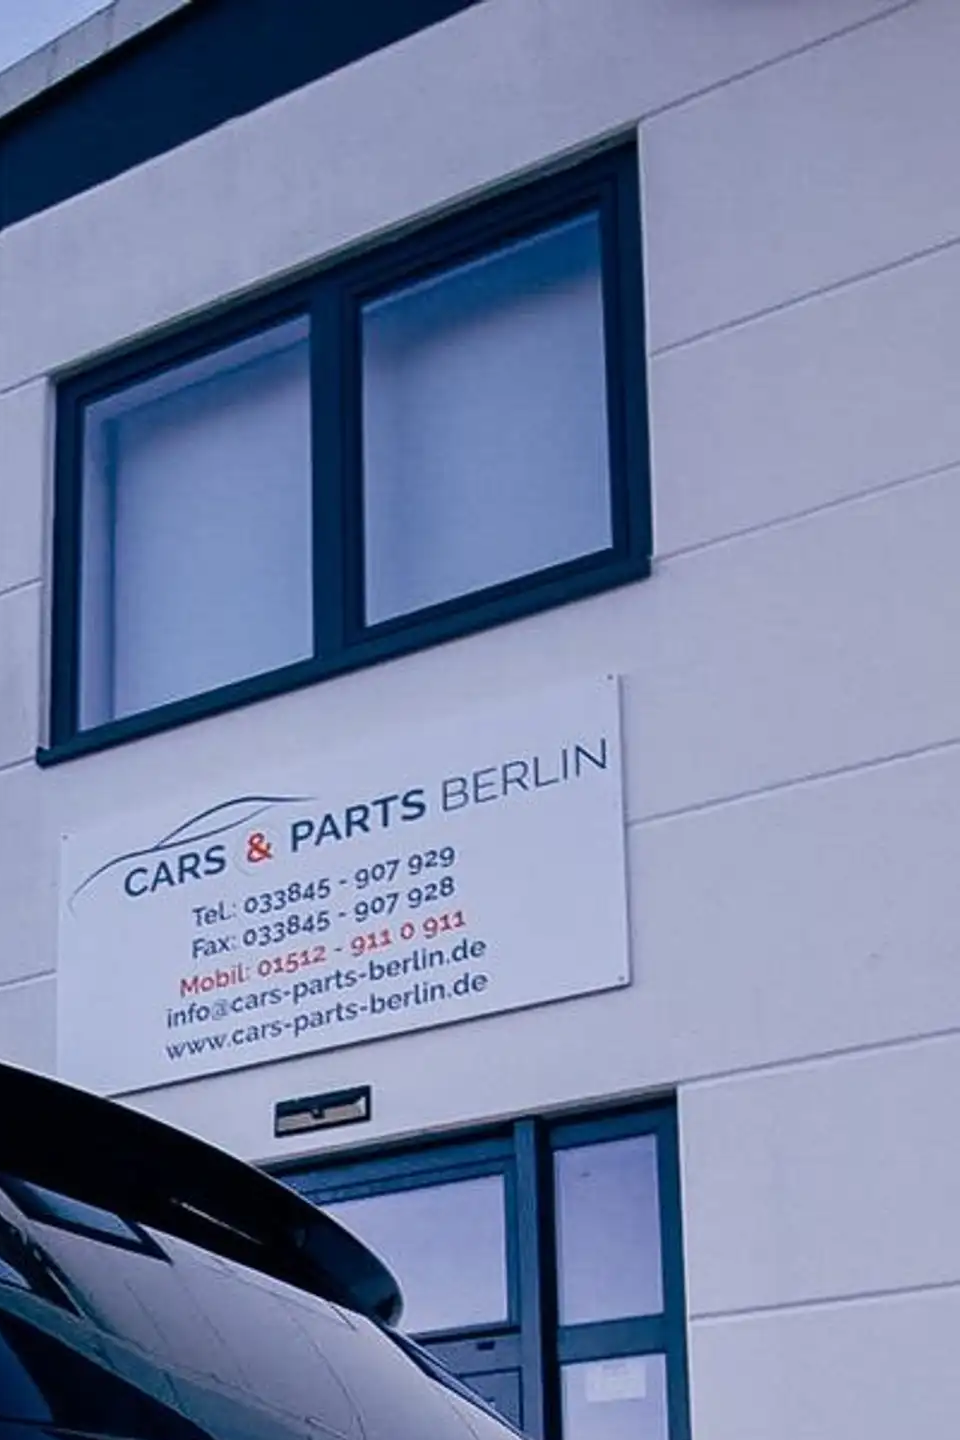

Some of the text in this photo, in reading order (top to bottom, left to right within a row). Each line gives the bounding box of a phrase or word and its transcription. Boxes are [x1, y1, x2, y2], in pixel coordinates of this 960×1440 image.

[123, 737, 607, 898] CARS & PARTS BERLIN
[191, 935, 236, 959] Fax:
[242, 911, 331, 948] 033845
[353, 892, 400, 922] 907
[407, 876, 455, 909] 928
[243, 878, 331, 914] 033845
[354, 859, 400, 890] 907
[407, 846, 456, 876] 929
[165, 938, 487, 1029] info@cars-parts-berlin.de
[179, 963, 251, 997] Mobil:
[257, 945, 327, 977] 01512
[349, 928, 392, 958] 911
[400, 922, 415, 940] 0
[422, 910, 466, 939] 911
[165, 971, 489, 1061] www.cars-parts-berlin.de
